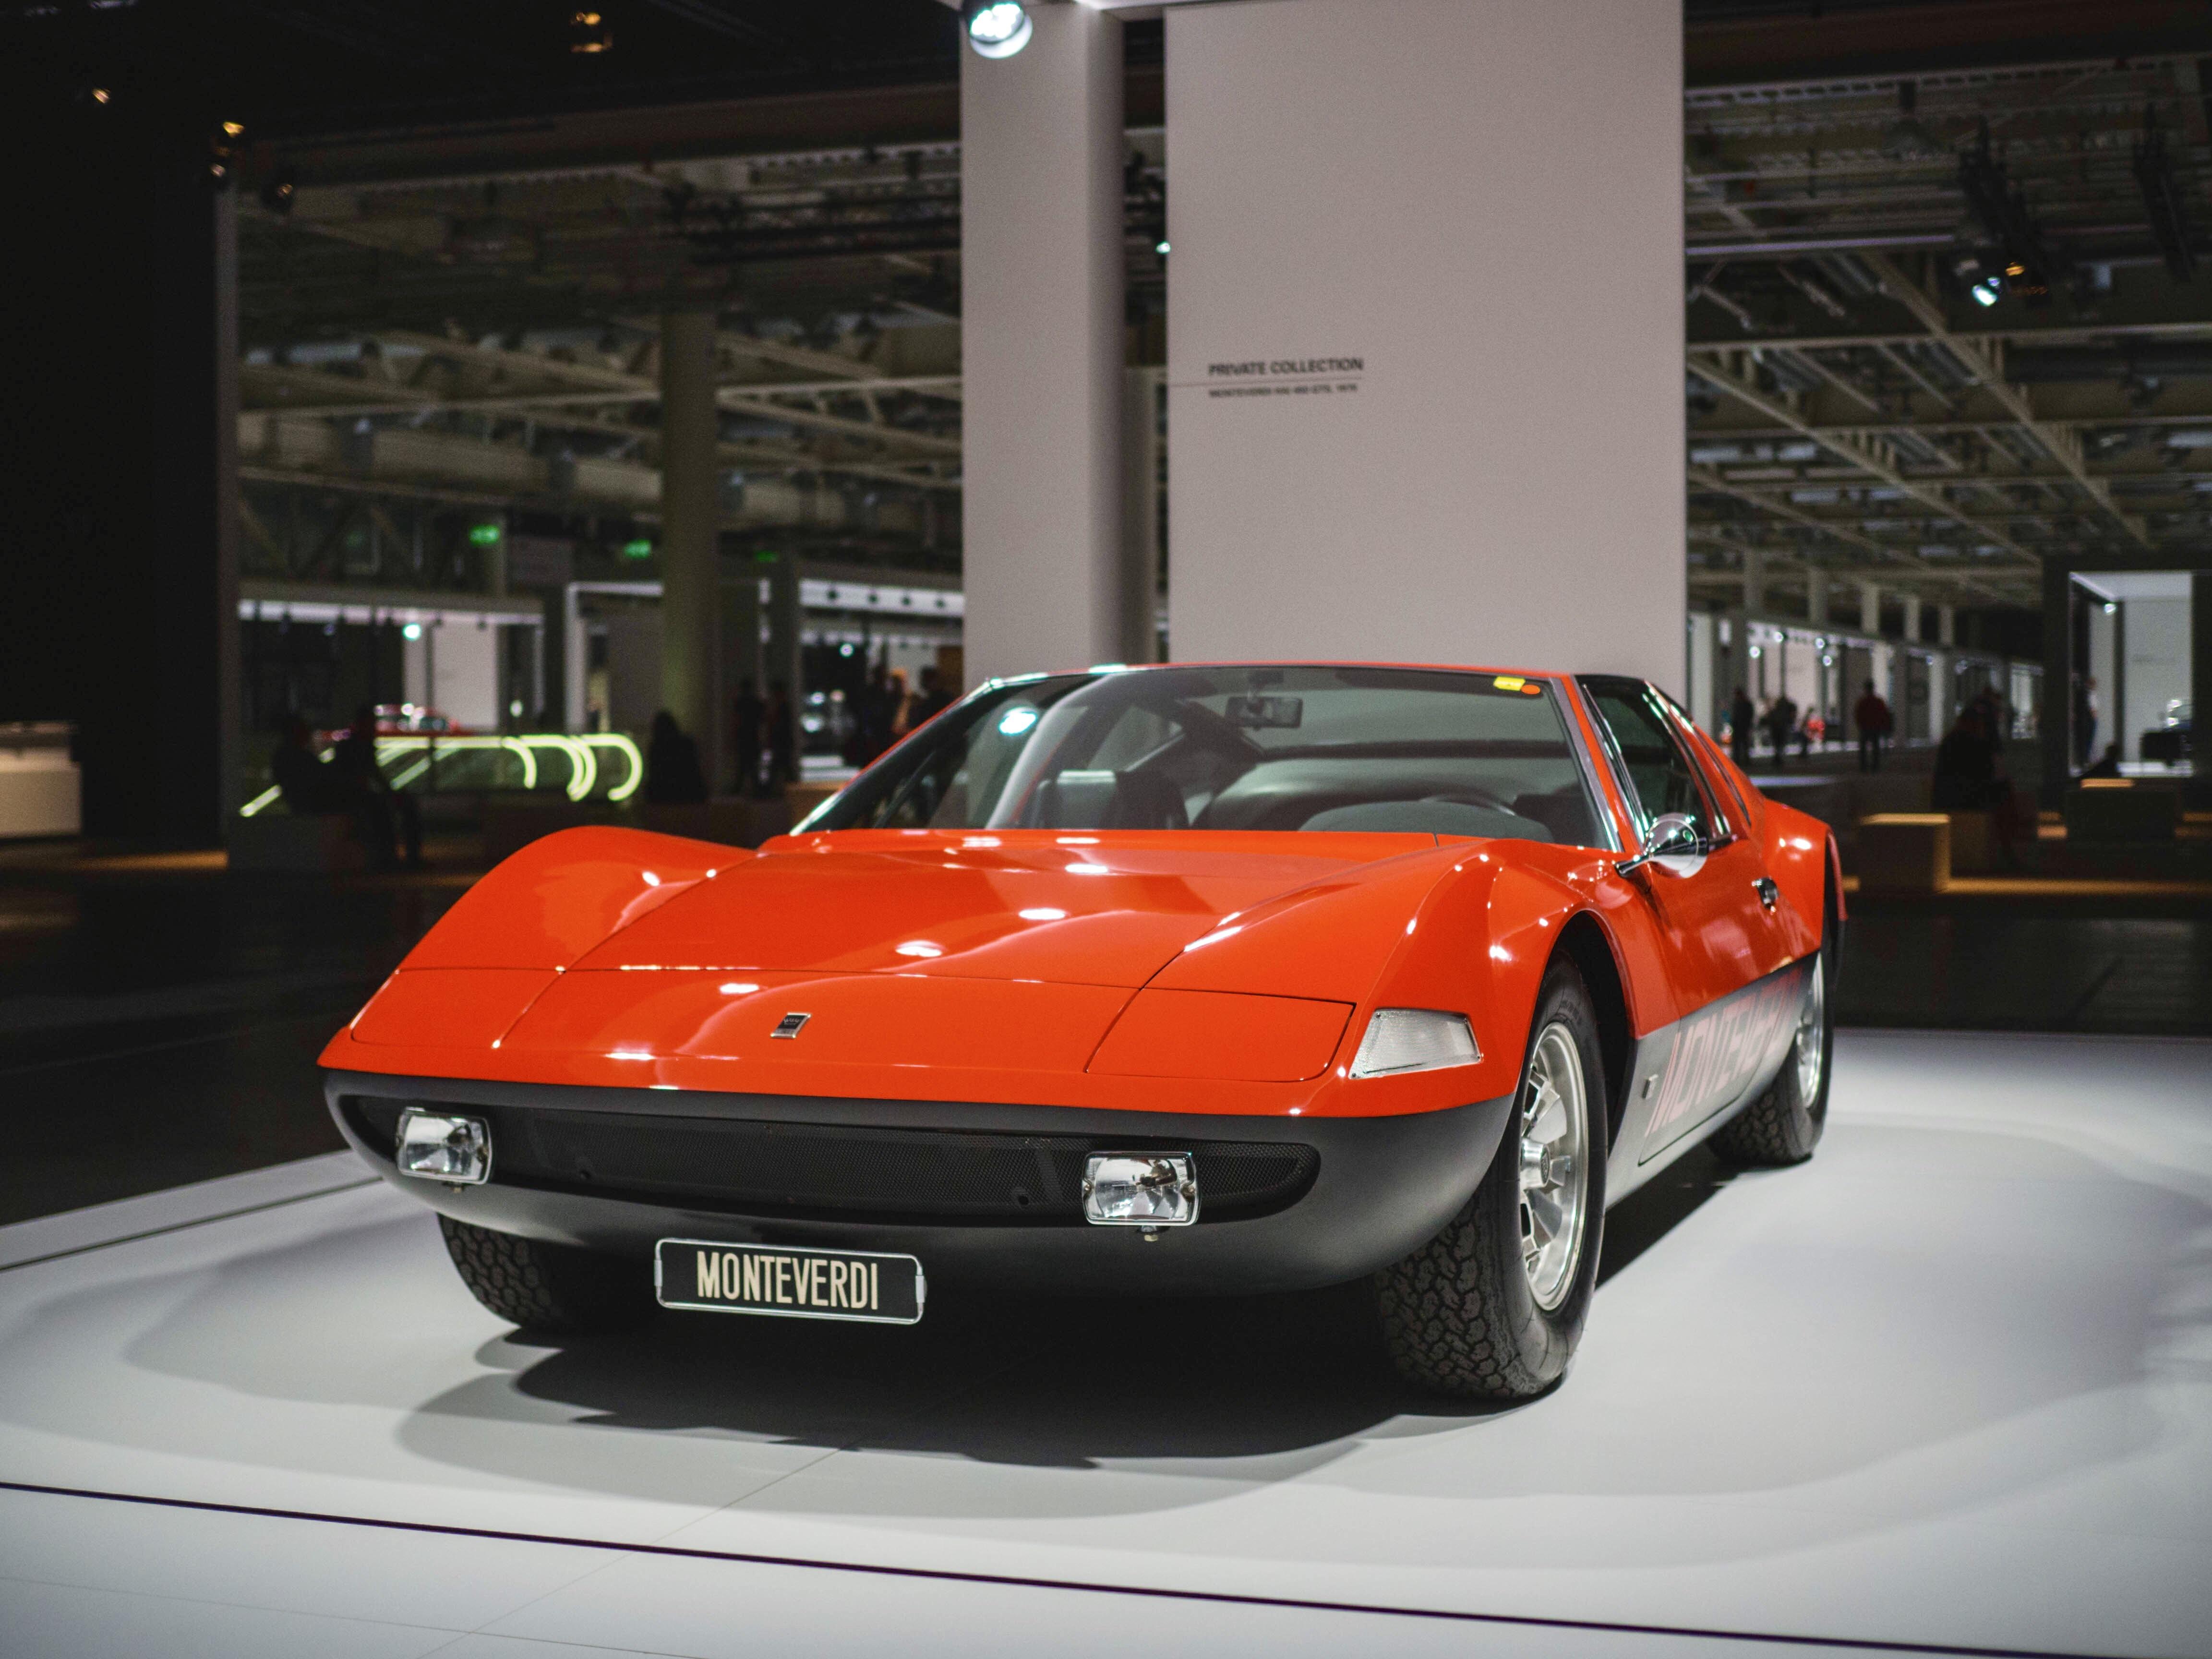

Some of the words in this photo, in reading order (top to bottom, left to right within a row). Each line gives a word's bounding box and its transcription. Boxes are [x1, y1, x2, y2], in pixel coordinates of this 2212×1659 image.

[1209, 361, 1265, 375] PRIVATE
[1270, 358, 1363, 373] COLLECTION
[697, 1250, 878, 1310] MONTEVERDI
